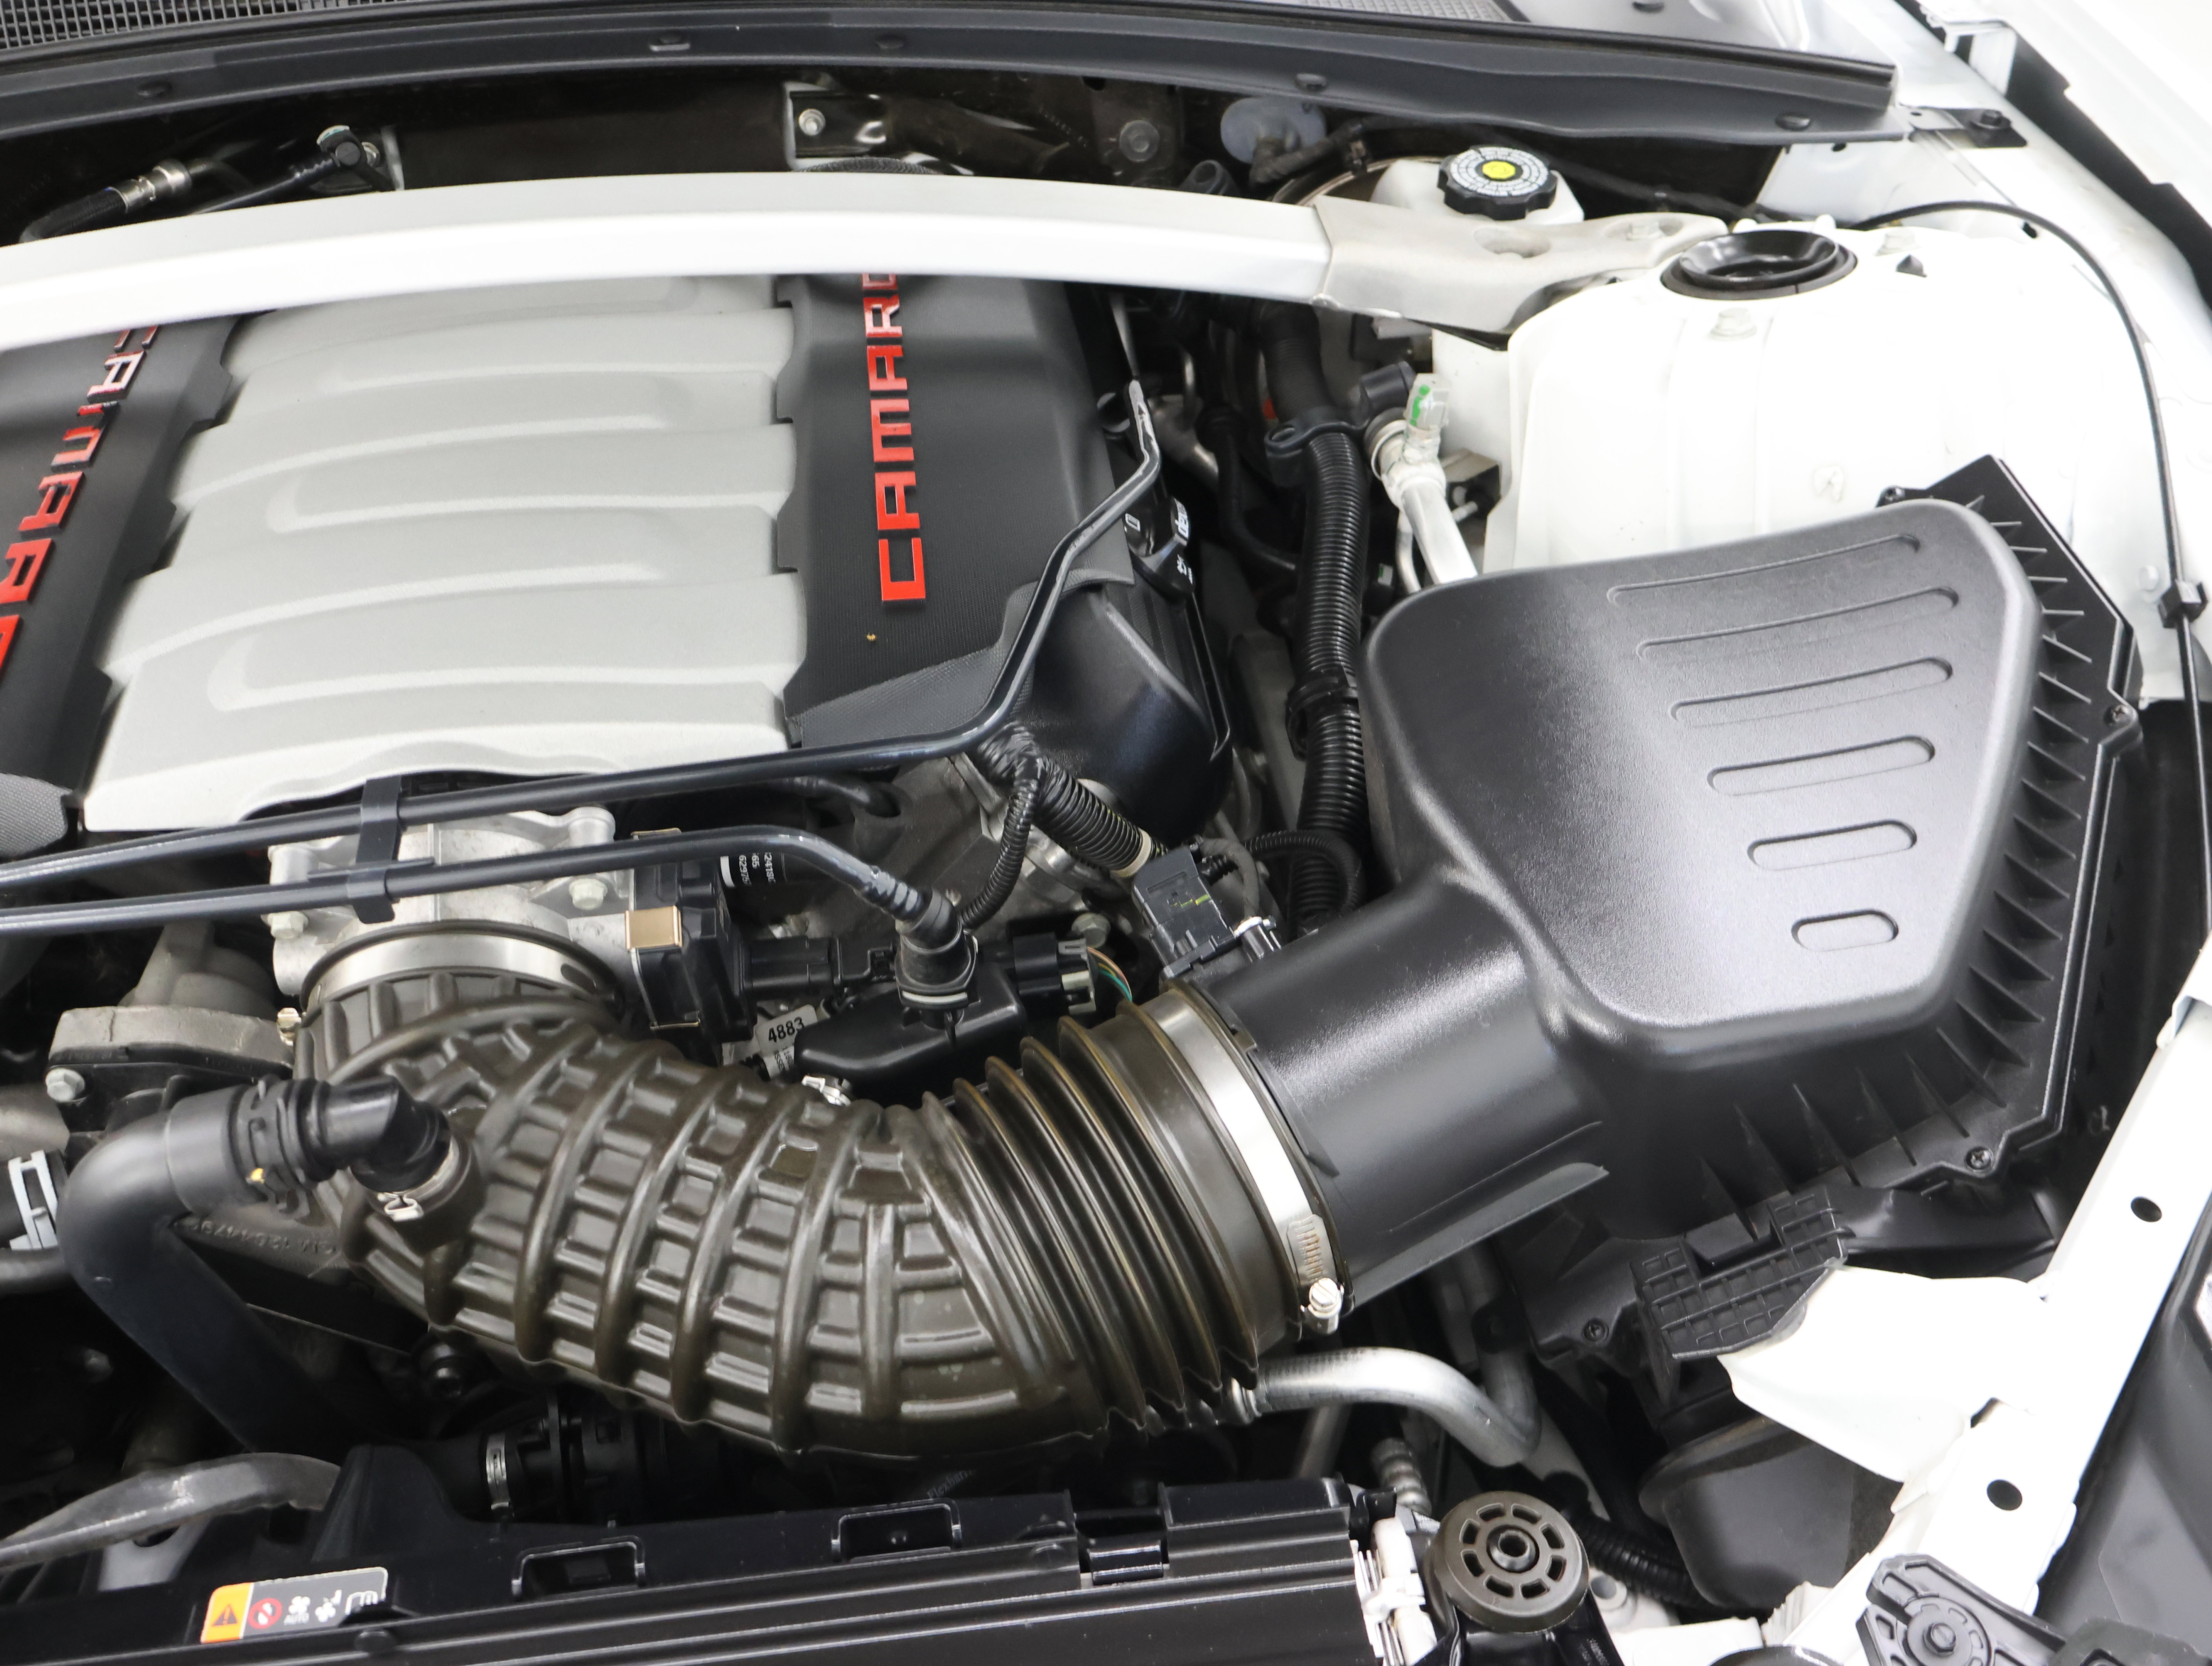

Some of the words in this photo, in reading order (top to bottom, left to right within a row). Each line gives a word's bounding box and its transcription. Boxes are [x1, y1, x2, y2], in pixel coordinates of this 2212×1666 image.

[0, 325, 158, 668] AMAR
[768, 1017, 804, 1043] 4883
[283, 1612, 310, 1626] AUTO
